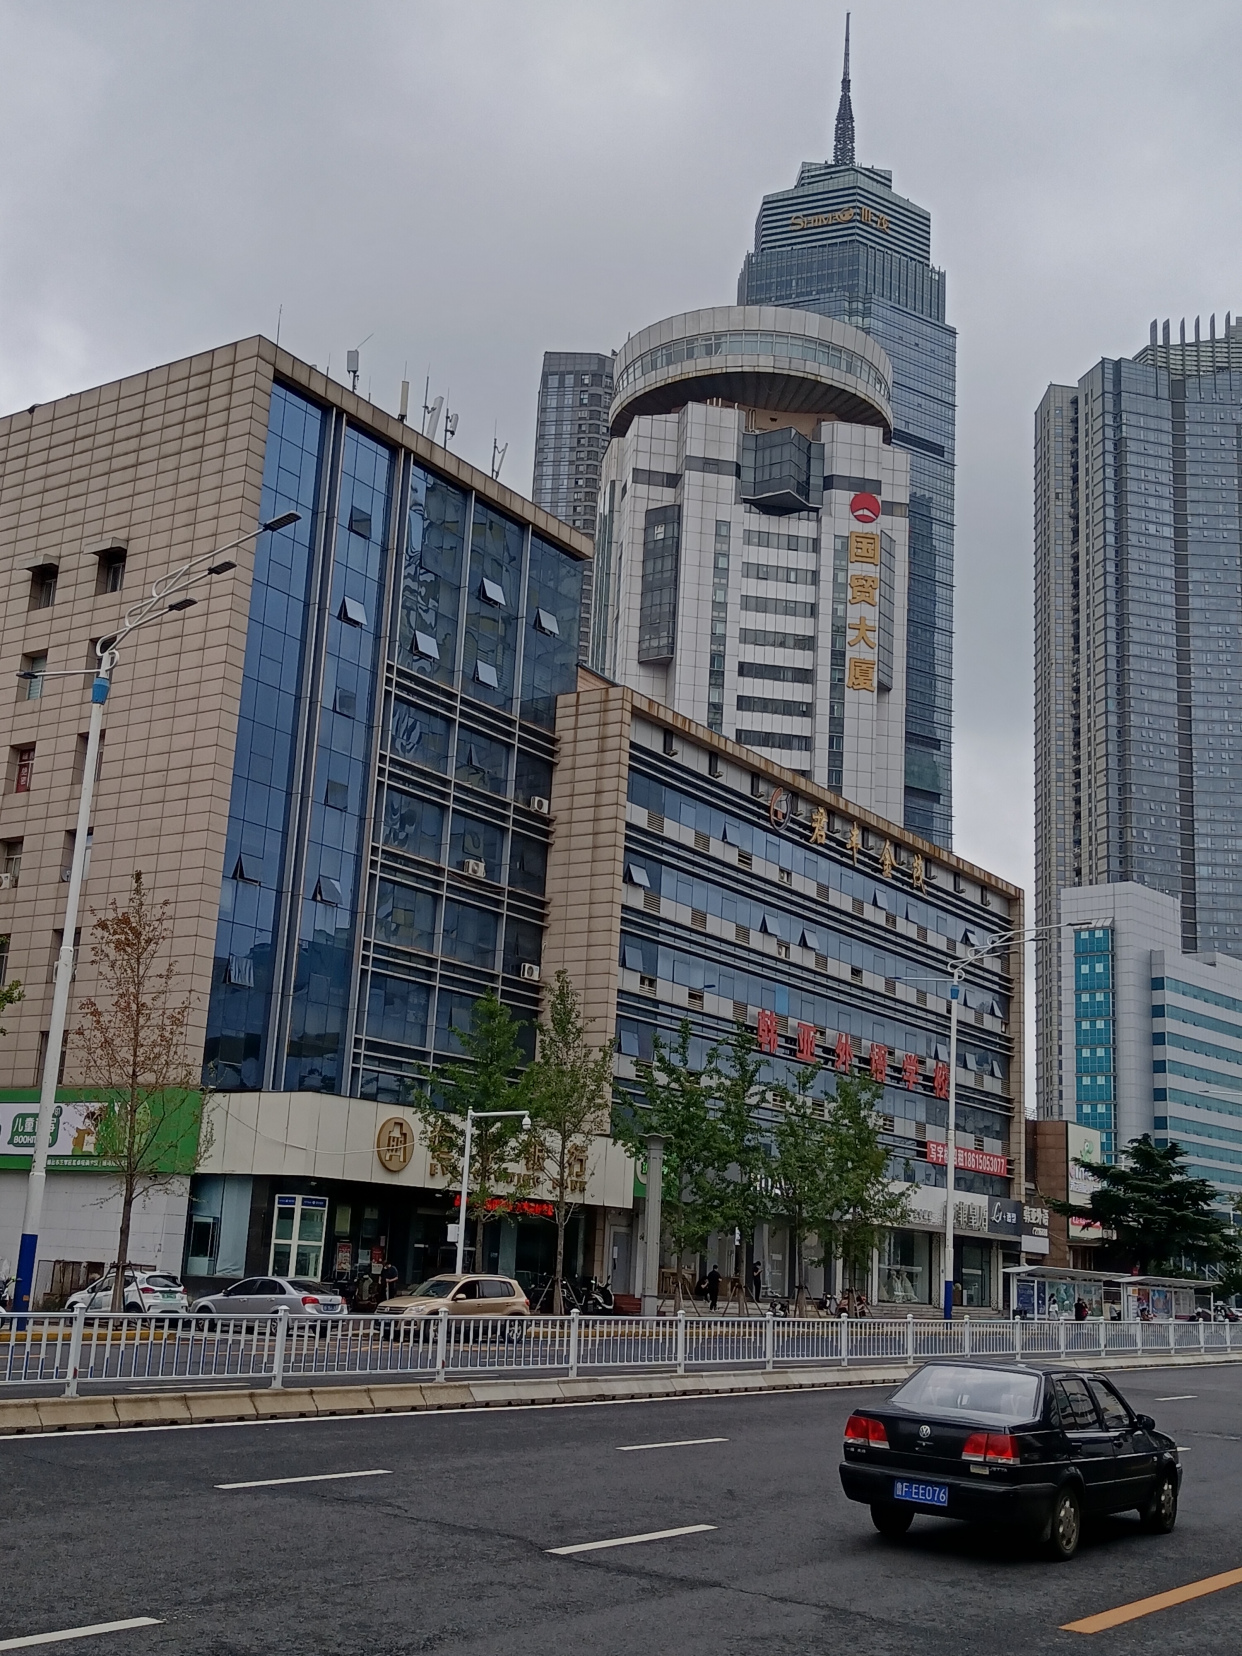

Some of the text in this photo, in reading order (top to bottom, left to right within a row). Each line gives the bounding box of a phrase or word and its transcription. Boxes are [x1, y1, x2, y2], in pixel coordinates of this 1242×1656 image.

[846, 531, 879, 692] 国贸大厦
[757, 1008, 951, 1100] 韩亚外语学校
